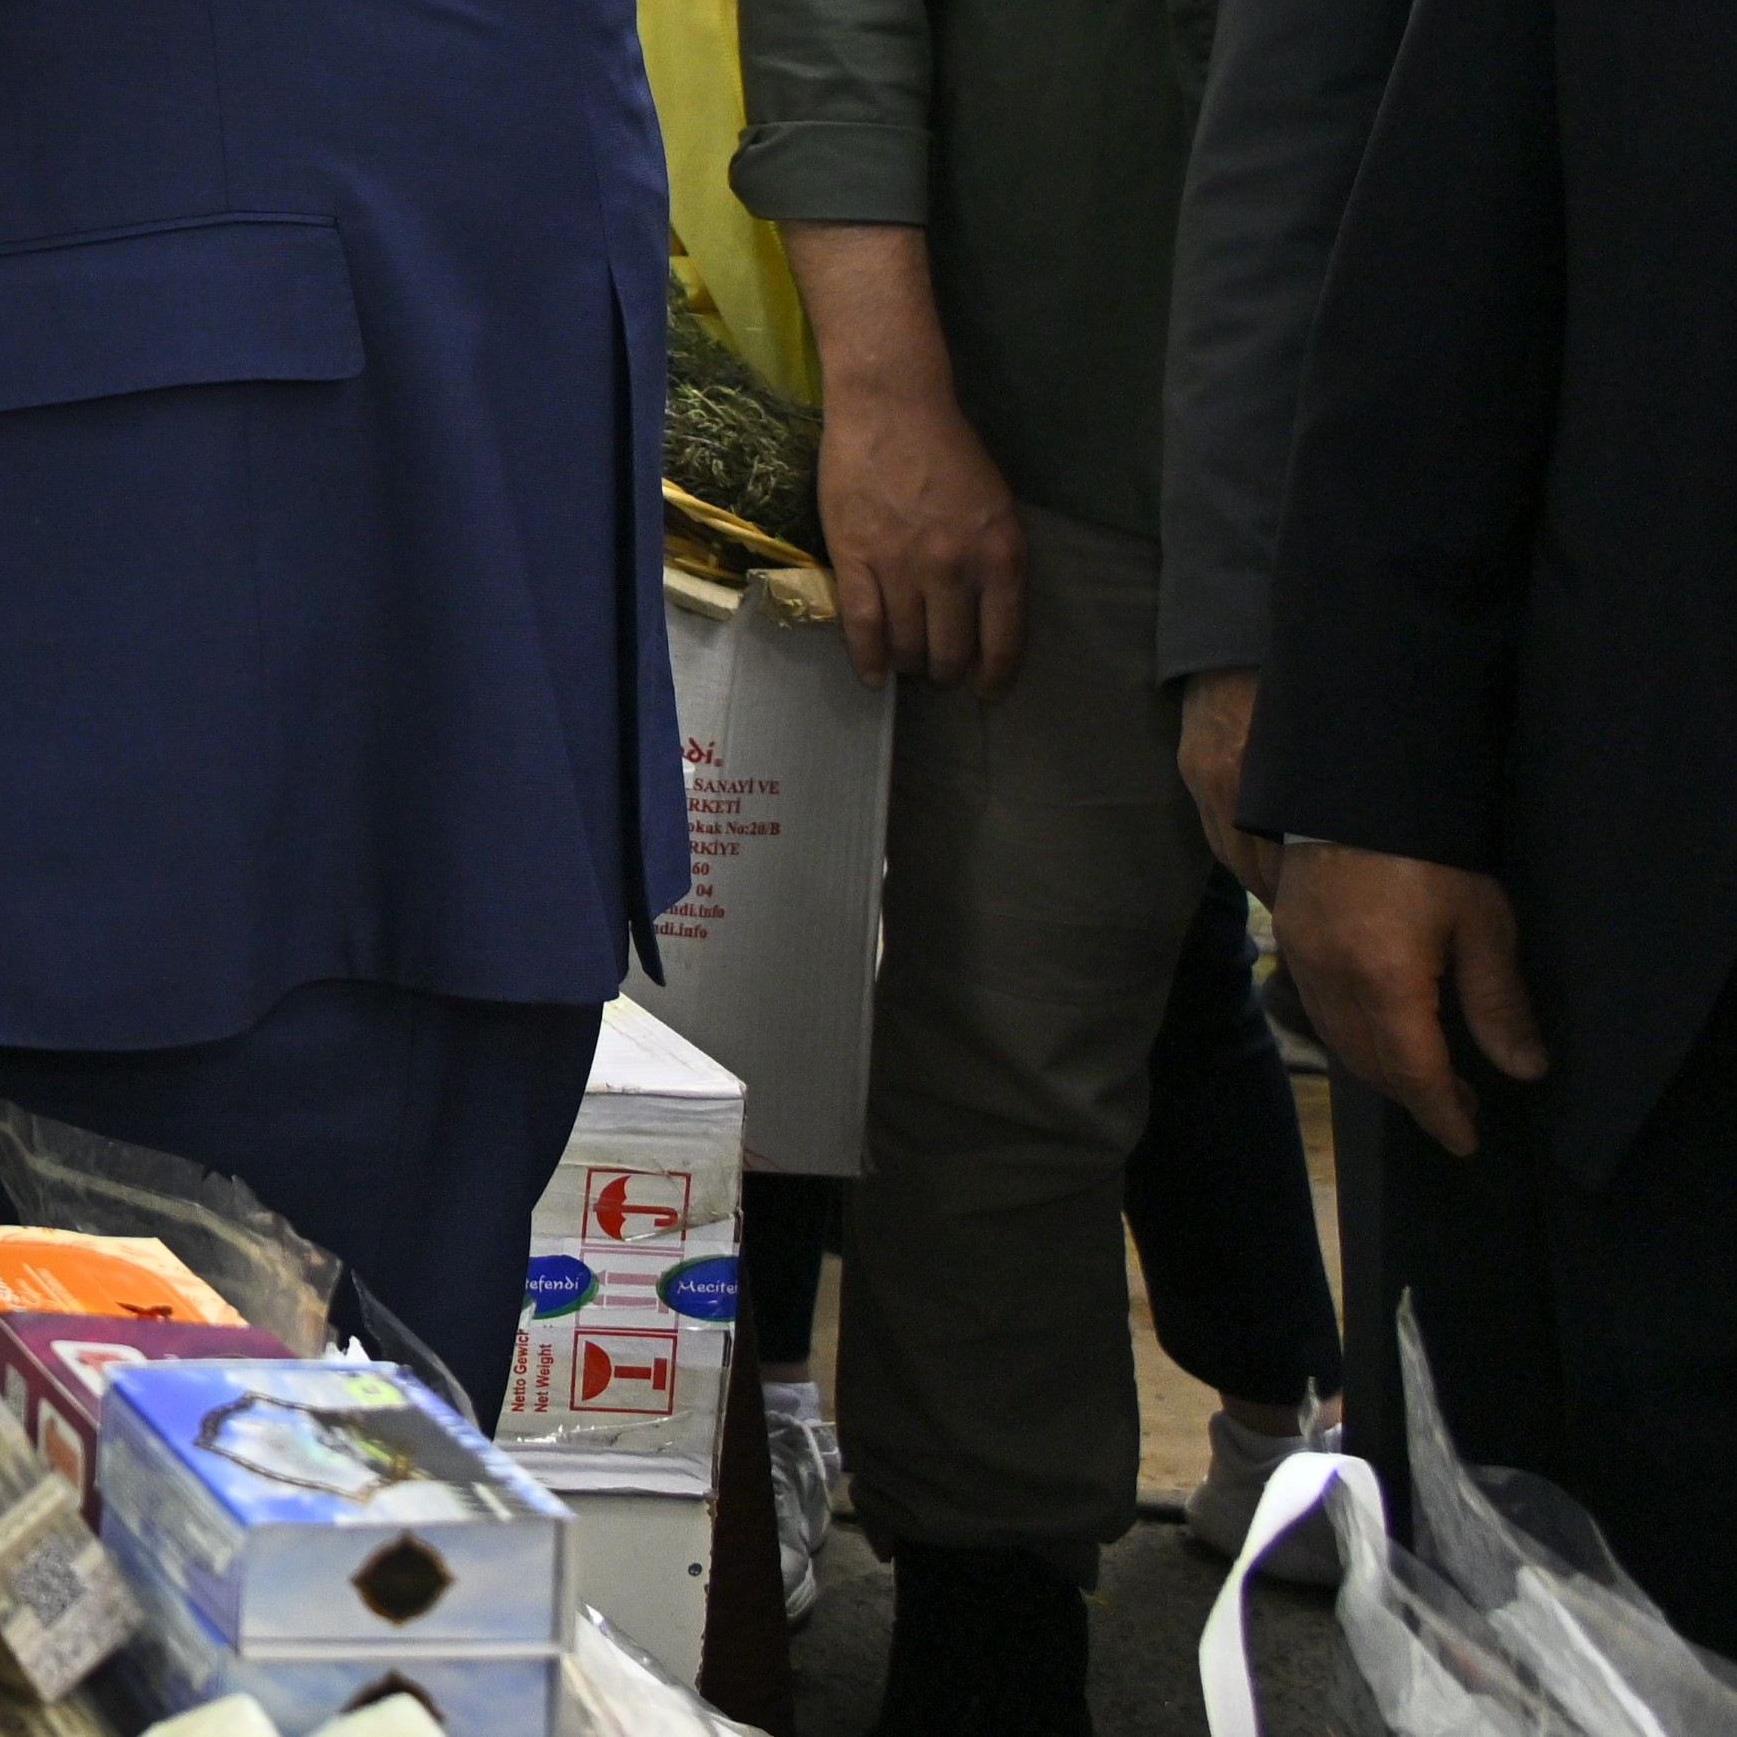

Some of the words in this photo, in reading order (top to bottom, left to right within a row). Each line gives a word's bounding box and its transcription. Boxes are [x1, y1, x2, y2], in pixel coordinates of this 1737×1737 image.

[693, 776, 754, 795] SANAYİ
[758, 780, 780, 795] VE
[688, 797, 741, 814] RKETİ
[688, 820, 723, 835] okak
[689, 840, 740, 856] RKİYE
[691, 862, 710, 876] 60
[695, 884, 714, 898] 04
[669, 902, 726, 919] ndi.info
[654, 921, 708, 940] ndi.info
[536, 1342, 554, 1389] Weight
[510, 1378, 527, 1413] Netto
[534, 1391, 548, 1413] Net
